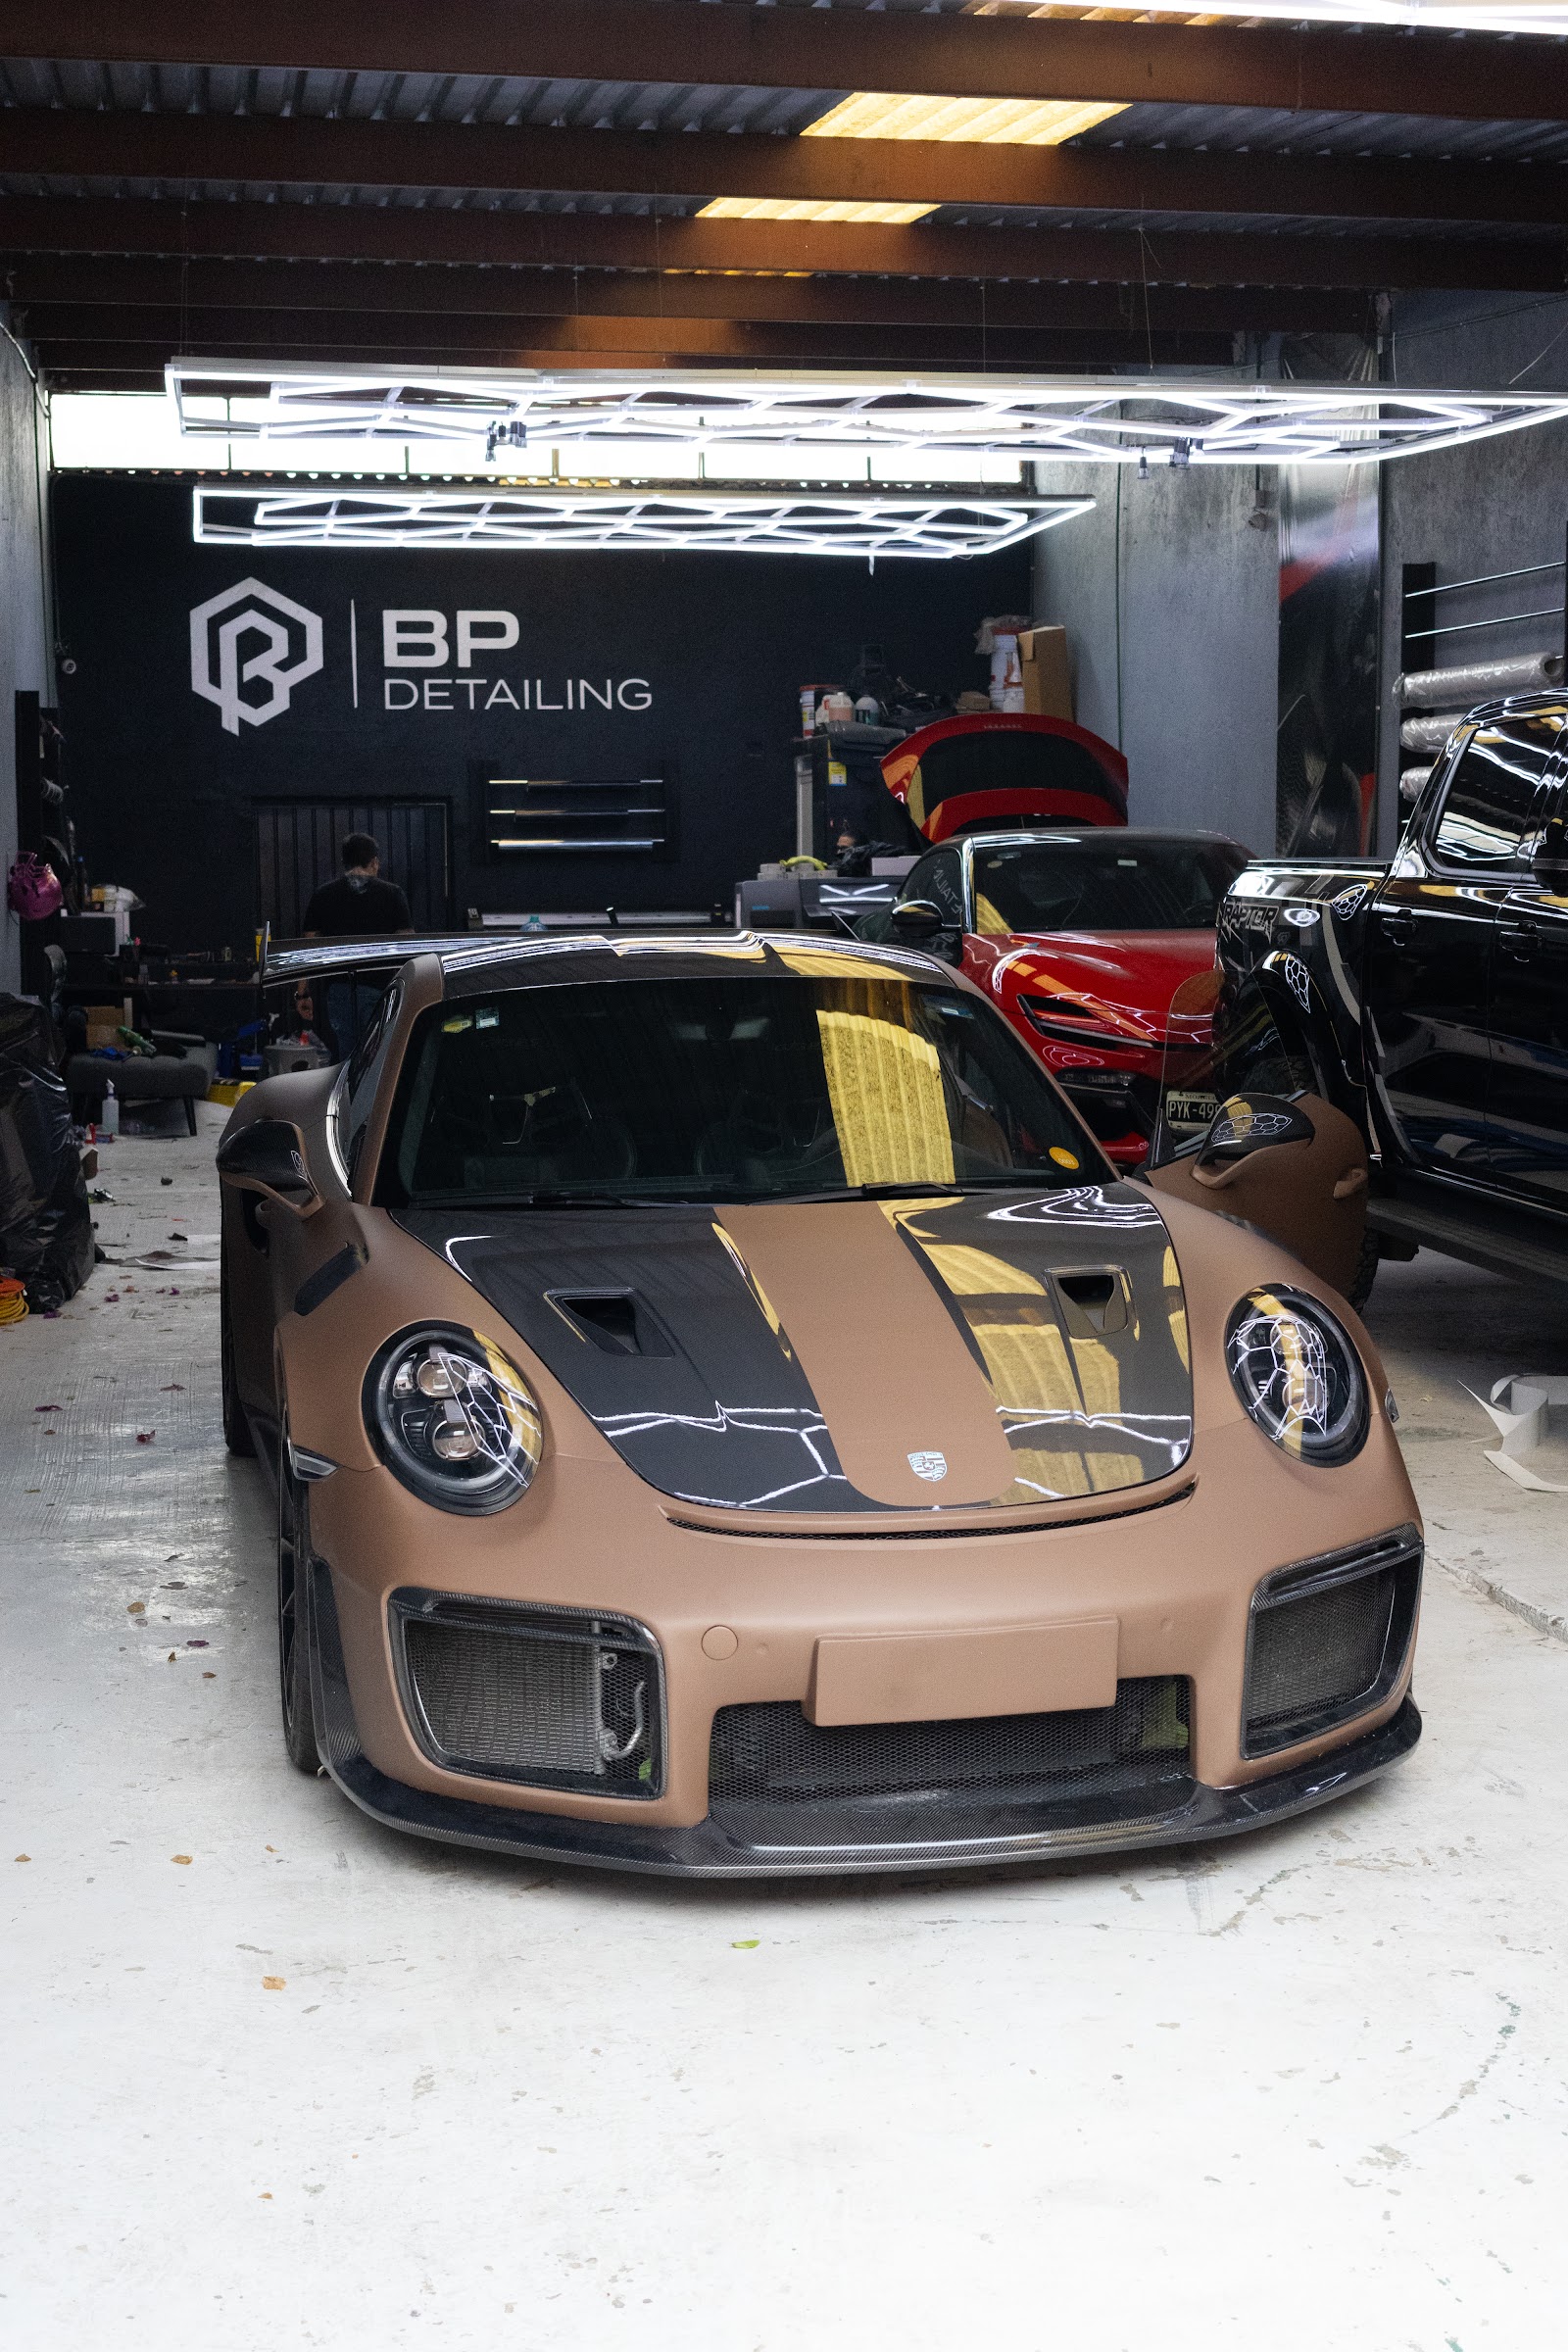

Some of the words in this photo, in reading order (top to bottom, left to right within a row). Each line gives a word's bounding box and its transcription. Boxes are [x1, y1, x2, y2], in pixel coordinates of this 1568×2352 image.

[382, 609, 520, 668] BP
[384, 678, 654, 710] DETAILING
[1222, 901, 1280, 944] RAPTOR
